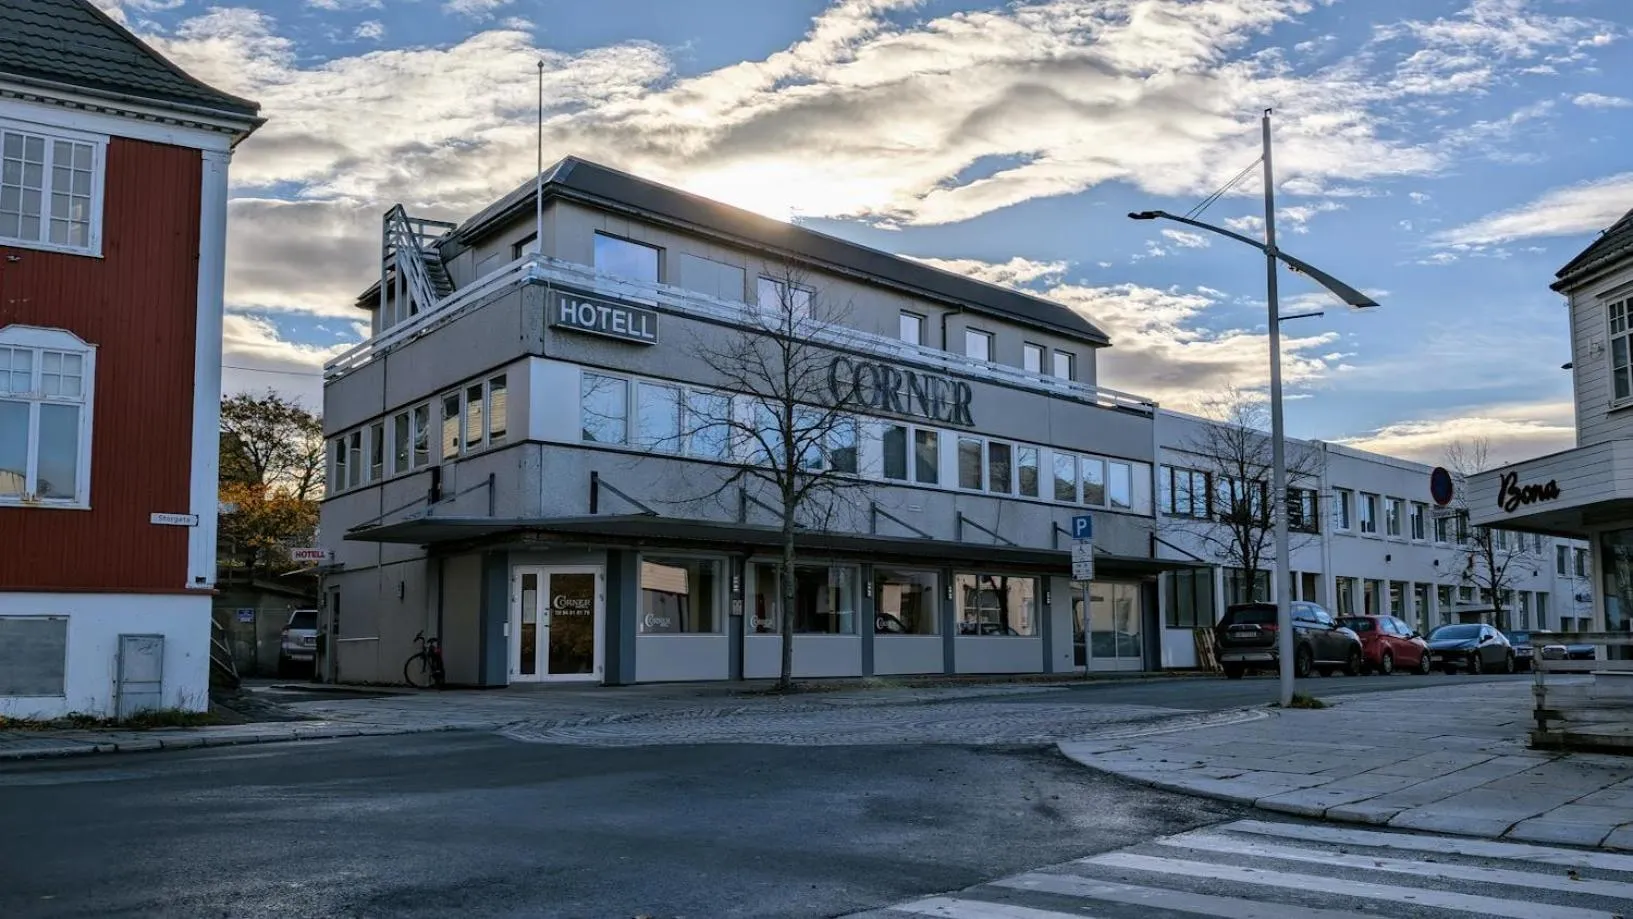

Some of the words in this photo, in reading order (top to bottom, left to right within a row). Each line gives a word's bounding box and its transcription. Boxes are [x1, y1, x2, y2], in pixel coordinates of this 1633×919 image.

[560, 298, 655, 339] HOTELL
[827, 356, 976, 427] CORNER
[1497, 471, 1561, 513] Bona
[1076, 518, 1088, 537] P
[295, 550, 325, 559] HOTELL
[553, 594, 591, 609] CORNER
